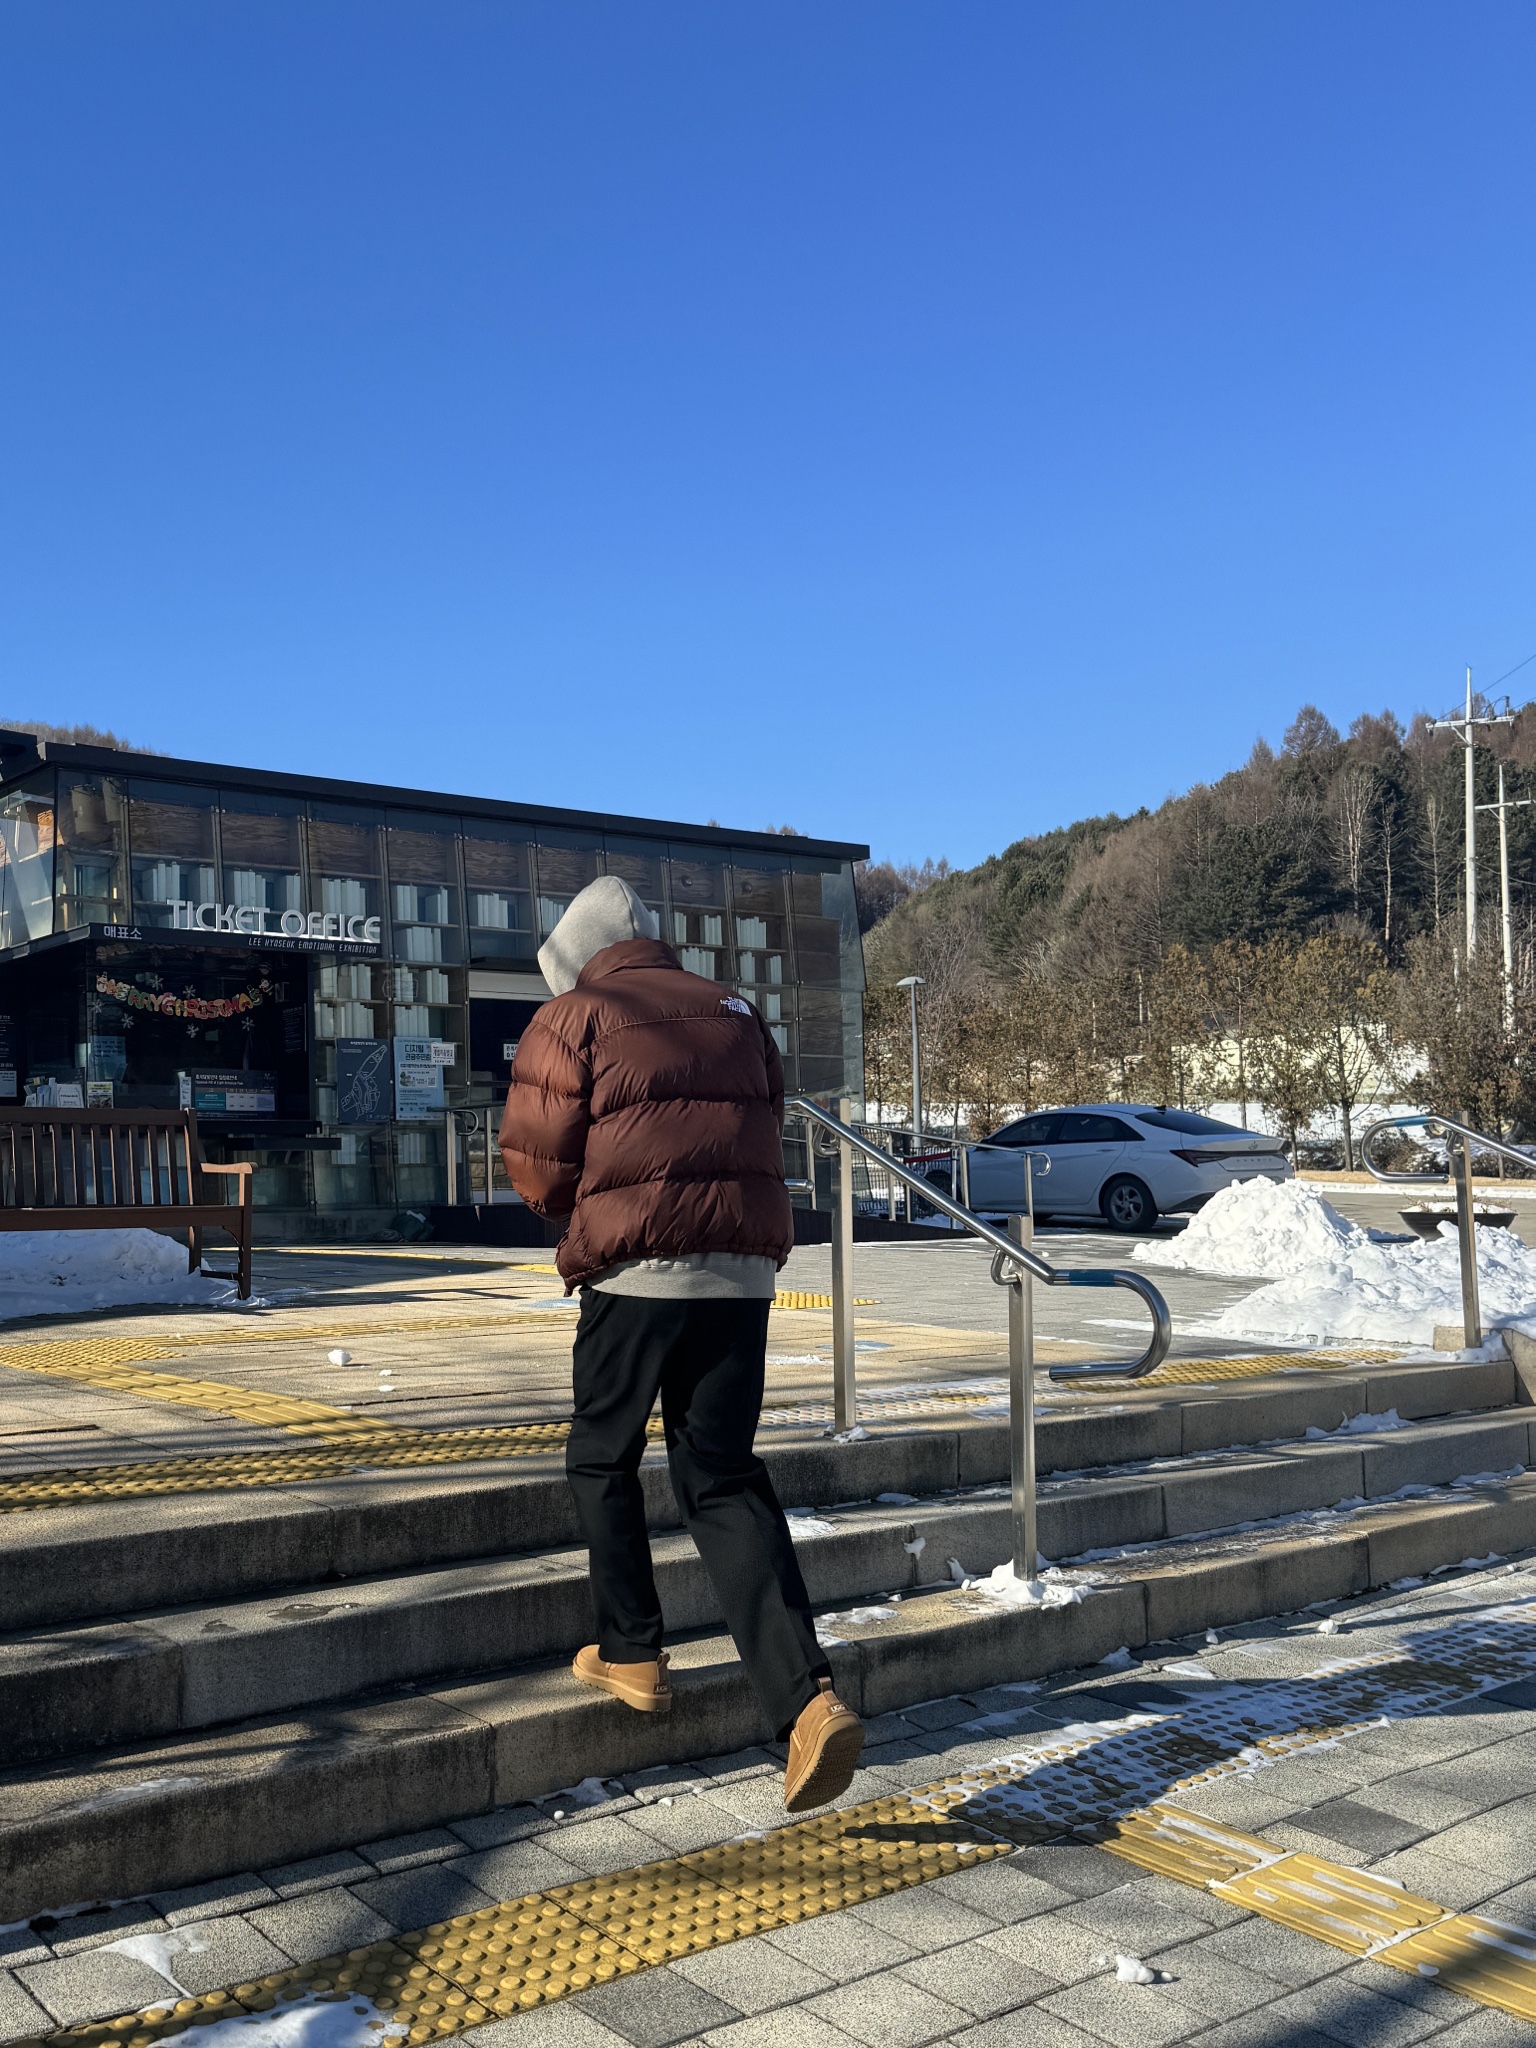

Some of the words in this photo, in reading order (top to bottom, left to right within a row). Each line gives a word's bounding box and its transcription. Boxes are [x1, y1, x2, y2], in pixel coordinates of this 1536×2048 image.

[167, 899, 270, 935] TICKET
[280, 909, 381, 943] OFFICE
[103, 926, 142, 940] 매표소
[248, 937, 262, 946] LEE
[298, 941, 335, 951] EMOTIONAL
[339, 943, 377, 954] EXHIBITION
[405, 1044, 424, 1053] 디지털
